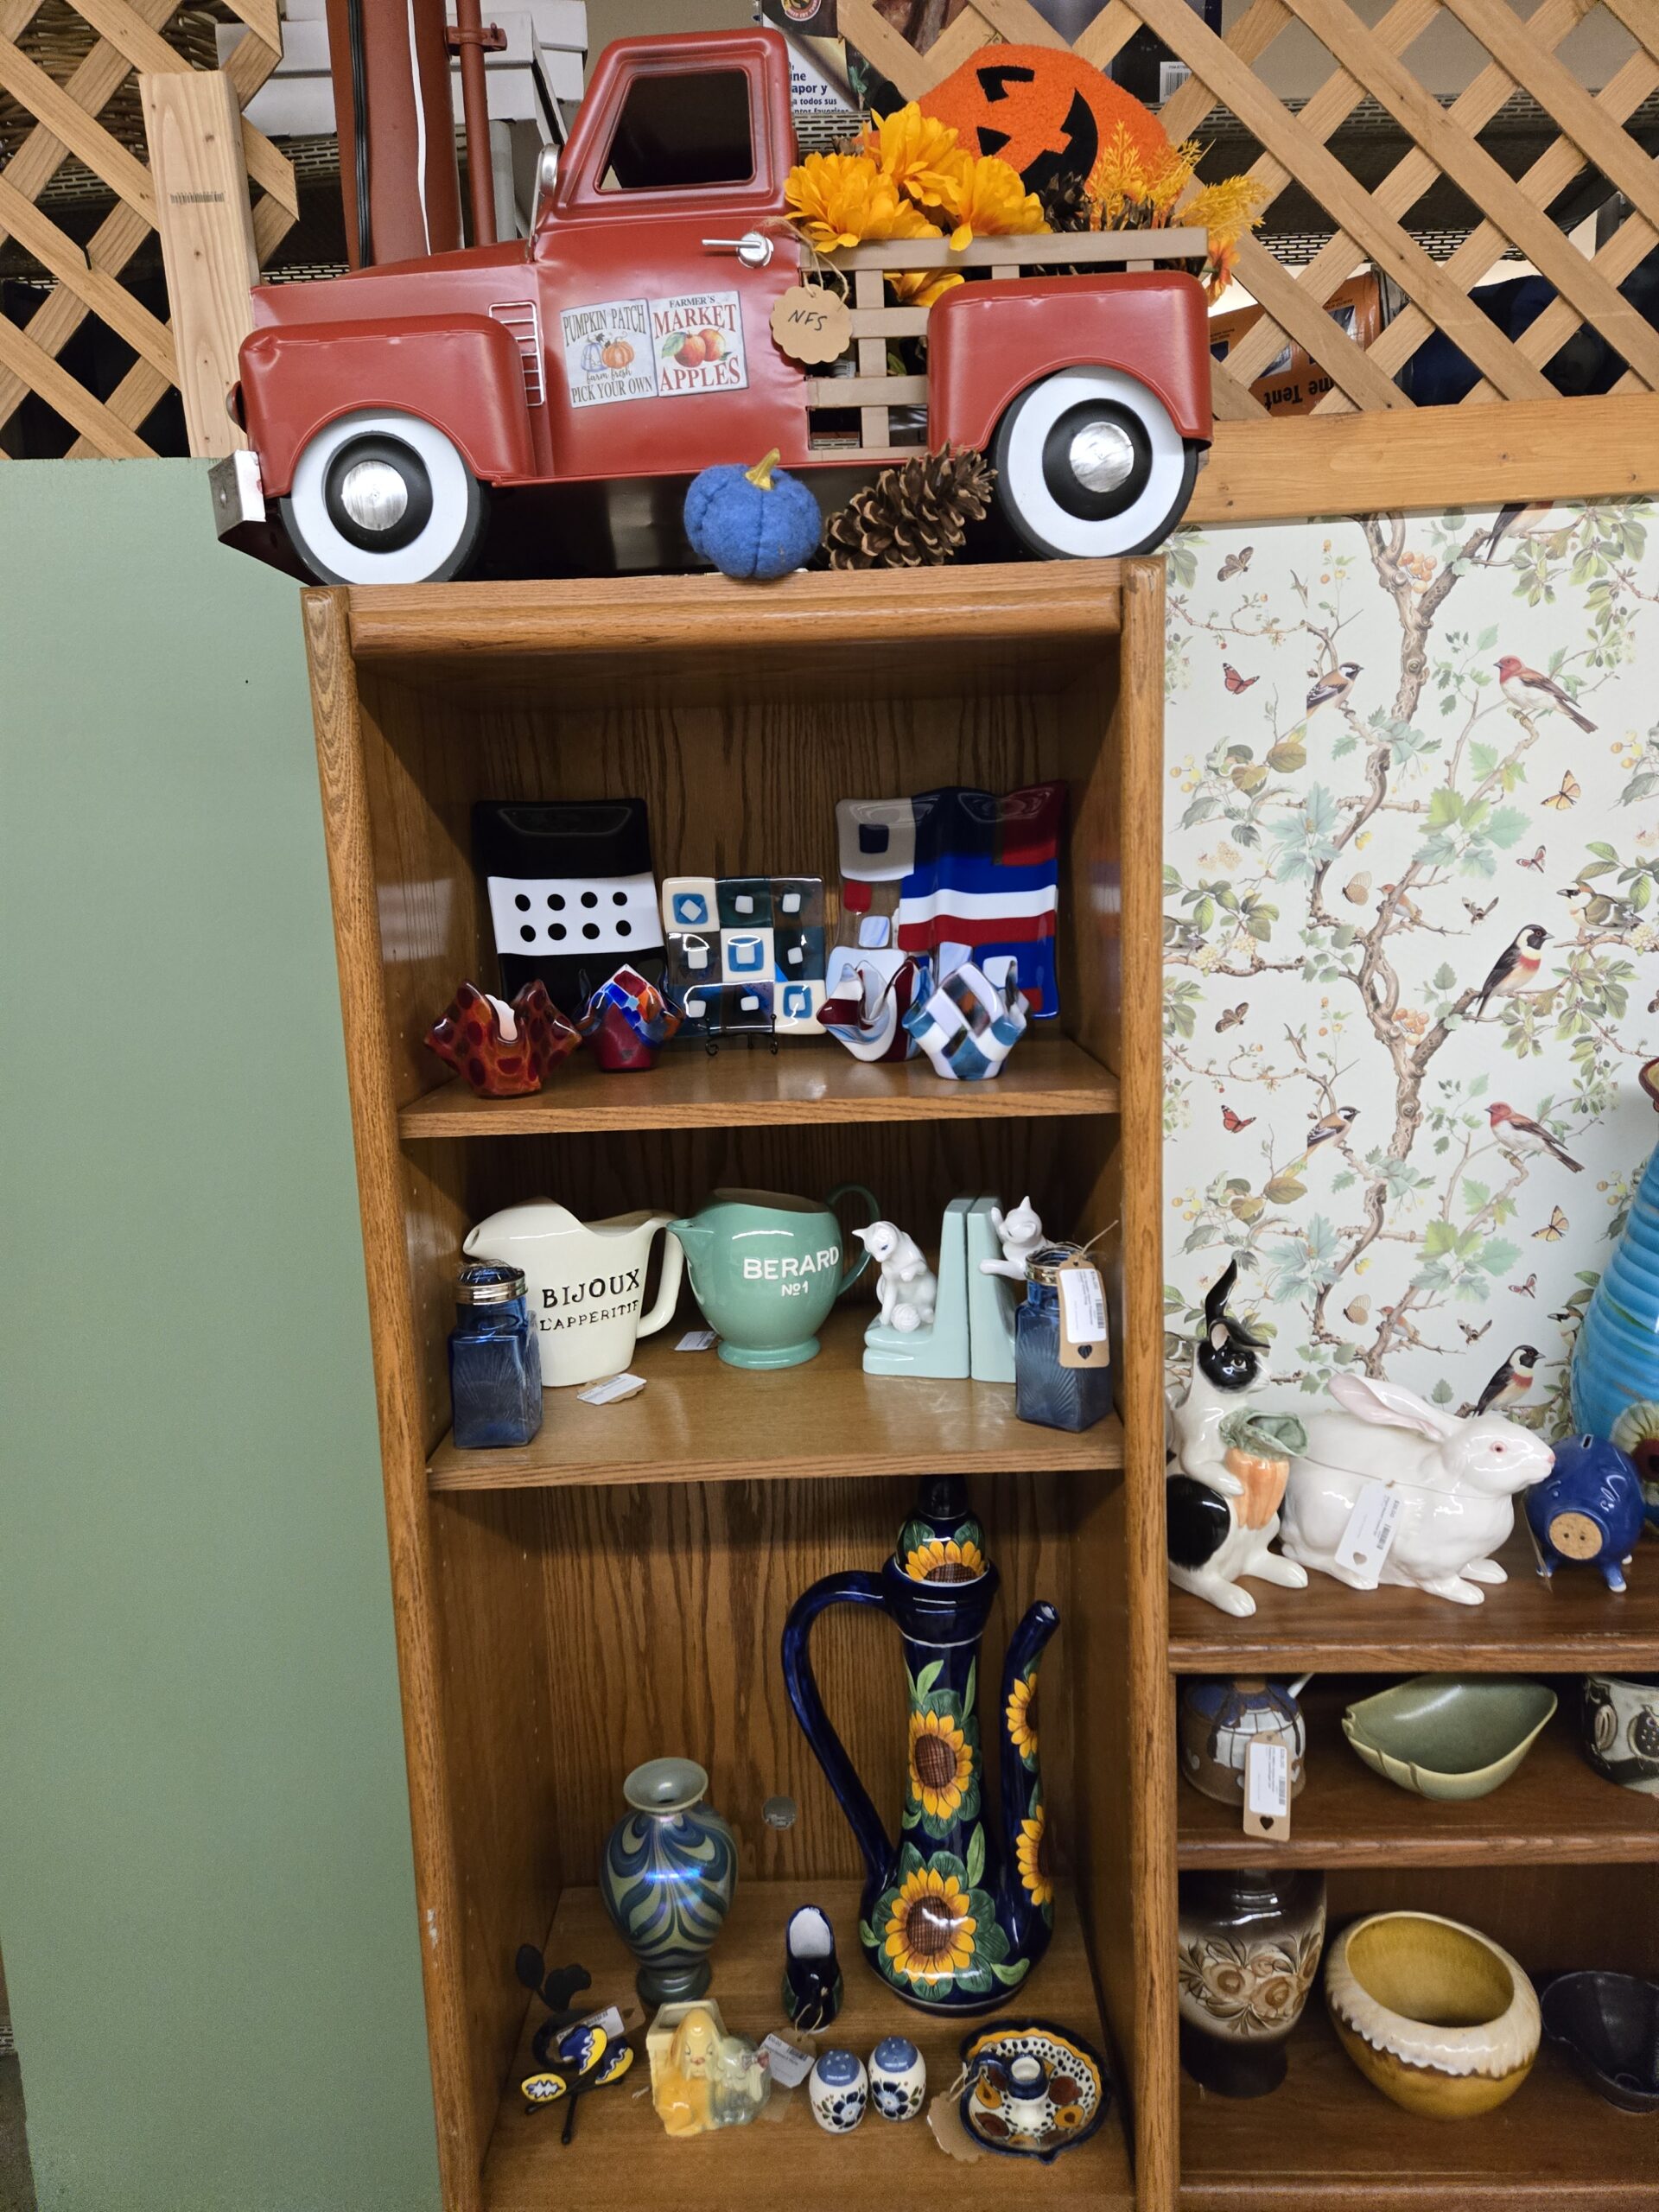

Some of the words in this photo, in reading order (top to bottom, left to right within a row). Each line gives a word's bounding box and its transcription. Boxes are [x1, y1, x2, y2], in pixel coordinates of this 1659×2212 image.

[791, 85, 817, 95] apor
[821, 85, 828, 95] y
[669, 296, 715, 308] FARMER'S
[563, 309, 607, 347] PUMPKIN
[611, 305, 647, 334] PATCH
[652, 304, 737, 340] MARKET
[788, 309, 828, 331] NFS
[587, 370, 609, 385] farm
[610, 366, 632, 380] fresh
[660, 355, 741, 391] APPLES
[571, 385, 596, 404] PICK
[597, 380, 626, 398] YOUR
[628, 376, 654, 394] OWN
[1264, 385, 1303, 410] Tent
[1309, 378, 1336, 396] me
[744, 1246, 840, 1280] BERARD
[542, 1268, 640, 1308] BIJOUX
